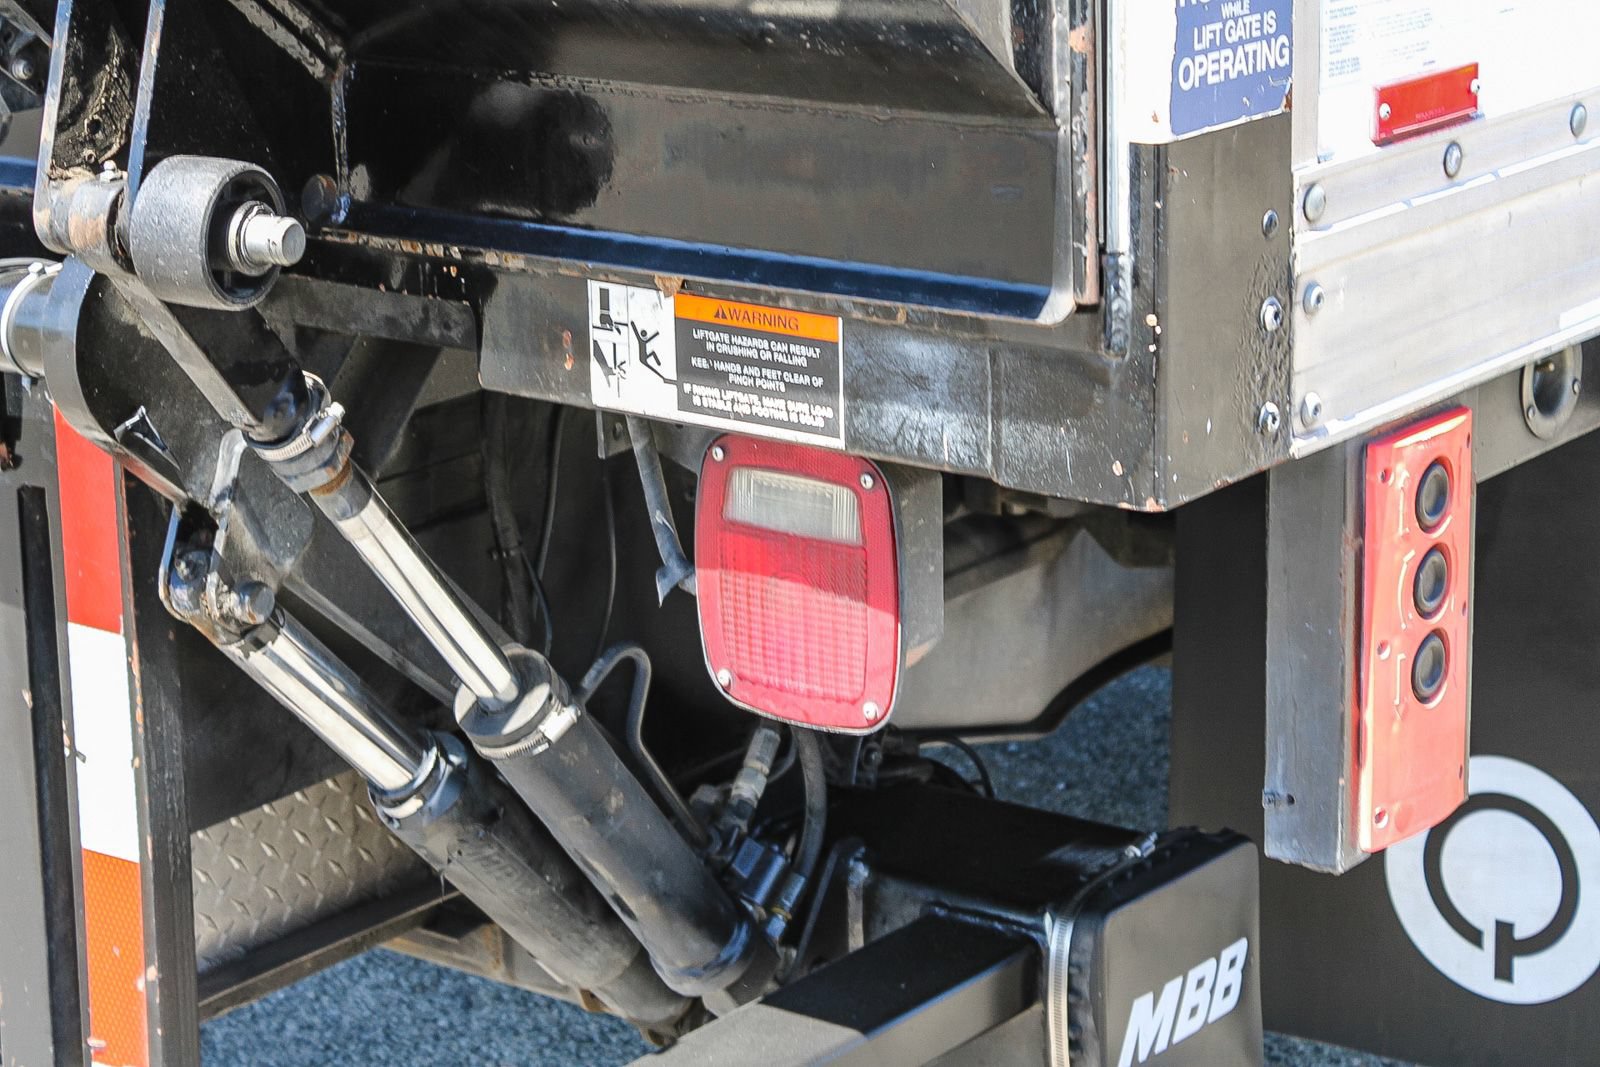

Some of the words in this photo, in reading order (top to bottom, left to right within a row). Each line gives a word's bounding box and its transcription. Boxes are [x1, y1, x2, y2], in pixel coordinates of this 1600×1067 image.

[1221, 0, 1250, 19] WHILE
[1193, 22, 1224, 51] LIFT
[1224, 13, 1261, 44] GATE
[1263, 10, 1277, 35] IS
[1178, 34, 1290, 91] OPERATING
[728, 307, 799, 331] WARNING
[692, 328, 730, 344] LIFTGATE
[731, 334, 769, 350] HAZARDS
[770, 341, 788, 353] CAN
[789, 344, 820, 359] RESULT
[706, 341, 715, 352] IN
[716, 343, 758, 359] CRUSHING
[760, 350, 772, 361] OR
[773, 352, 808, 367] FALLING
[713, 360, 741, 374] HANDS
[742, 365, 760, 377] AND
[761, 367, 782, 381] FEET
[783, 371, 811, 386] CLEAR
[811, 376, 824, 388] OF
[728, 373, 754, 387] PINCH
[755, 378, 786, 393] POINTS
[810, 404, 834, 419] LOAD
[1117, 937, 1248, 1067] MBB
